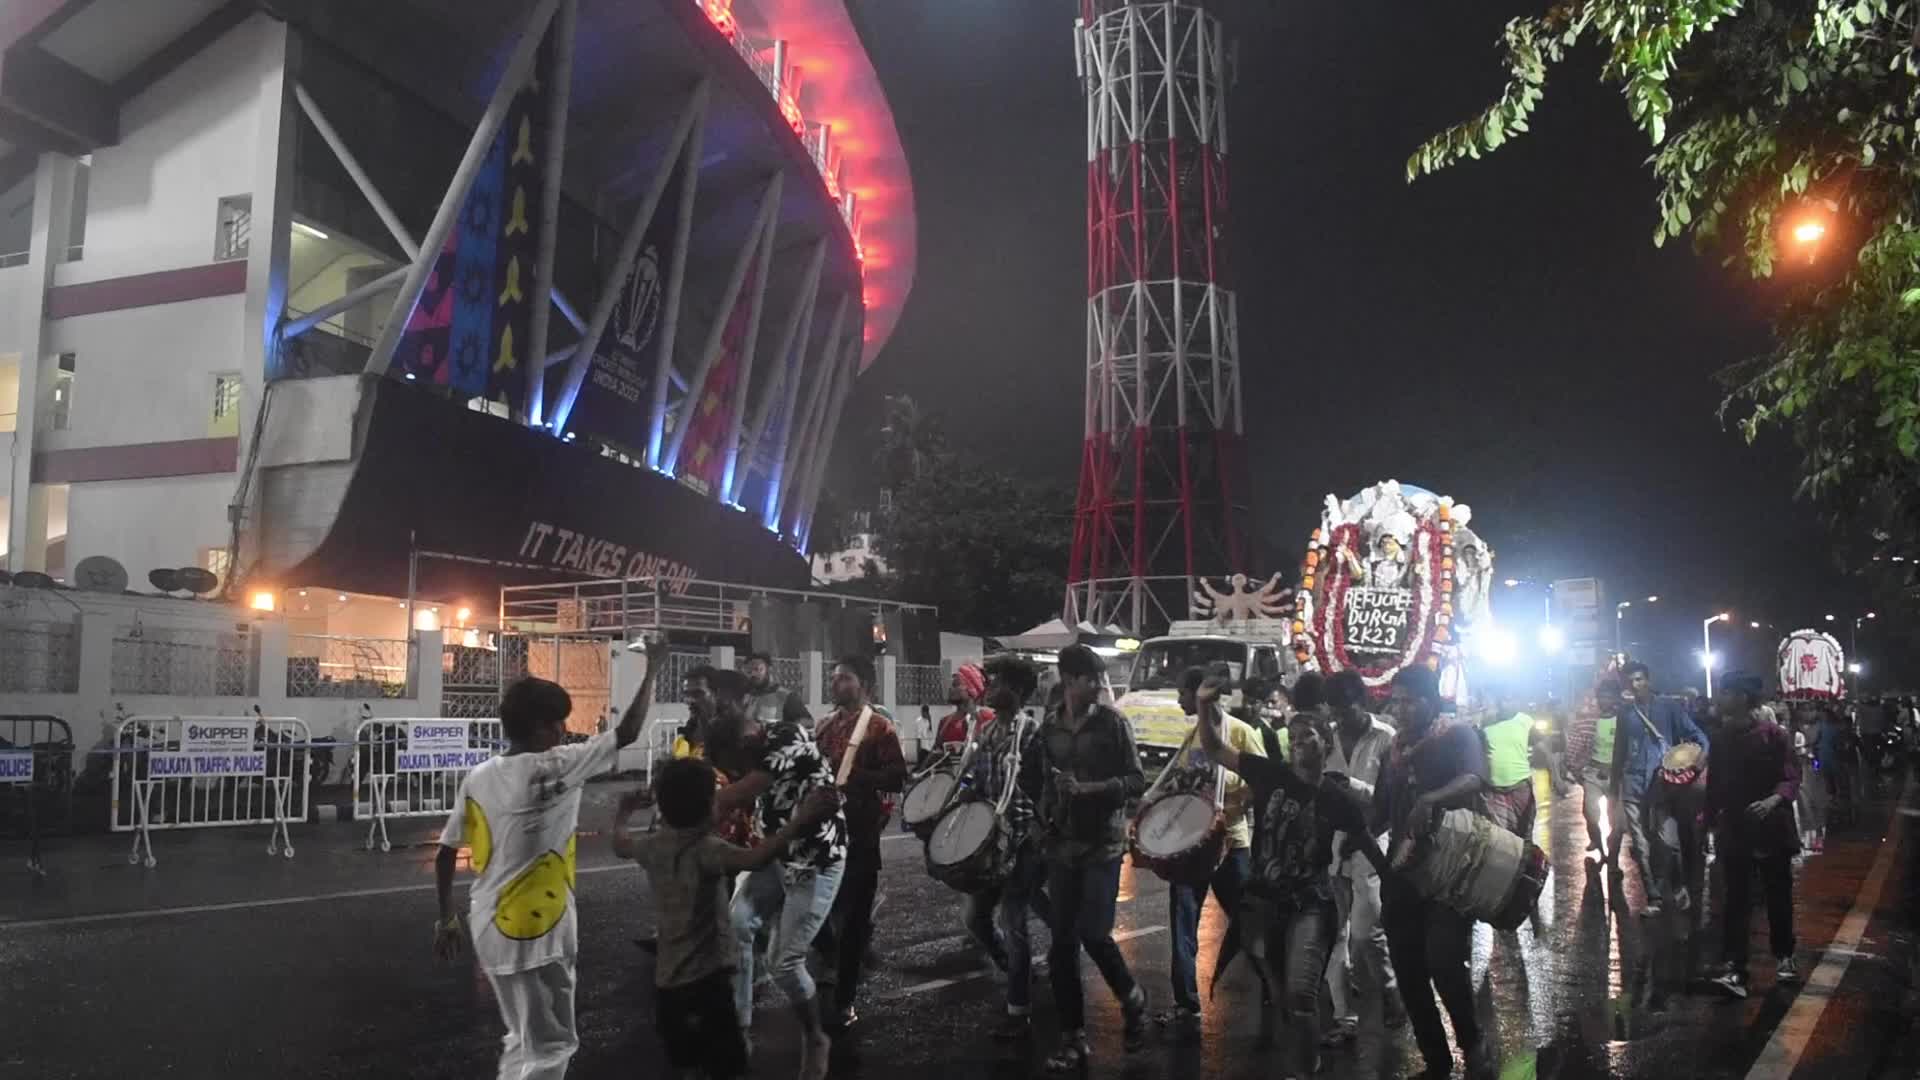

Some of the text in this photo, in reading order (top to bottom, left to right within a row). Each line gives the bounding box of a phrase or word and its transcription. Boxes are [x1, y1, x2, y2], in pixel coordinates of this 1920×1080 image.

[519, 521, 553, 559] IT
[552, 528, 627, 577] TAKES
[625, 551, 668, 591] ONE
[1343, 590, 1414, 611] REFUGEE
[1348, 607, 1407, 628] DURGA
[1348, 626, 1397, 645] 2K23
[188, 726, 249, 739] SKIPPER
[413, 725, 464, 738] SKIPPER
[150, 755, 264, 775] KOLKATA TRAFFIC POLICE
[399, 754, 431, 769] KOLKATA
[432, 753, 463, 768] TRAFFIC
